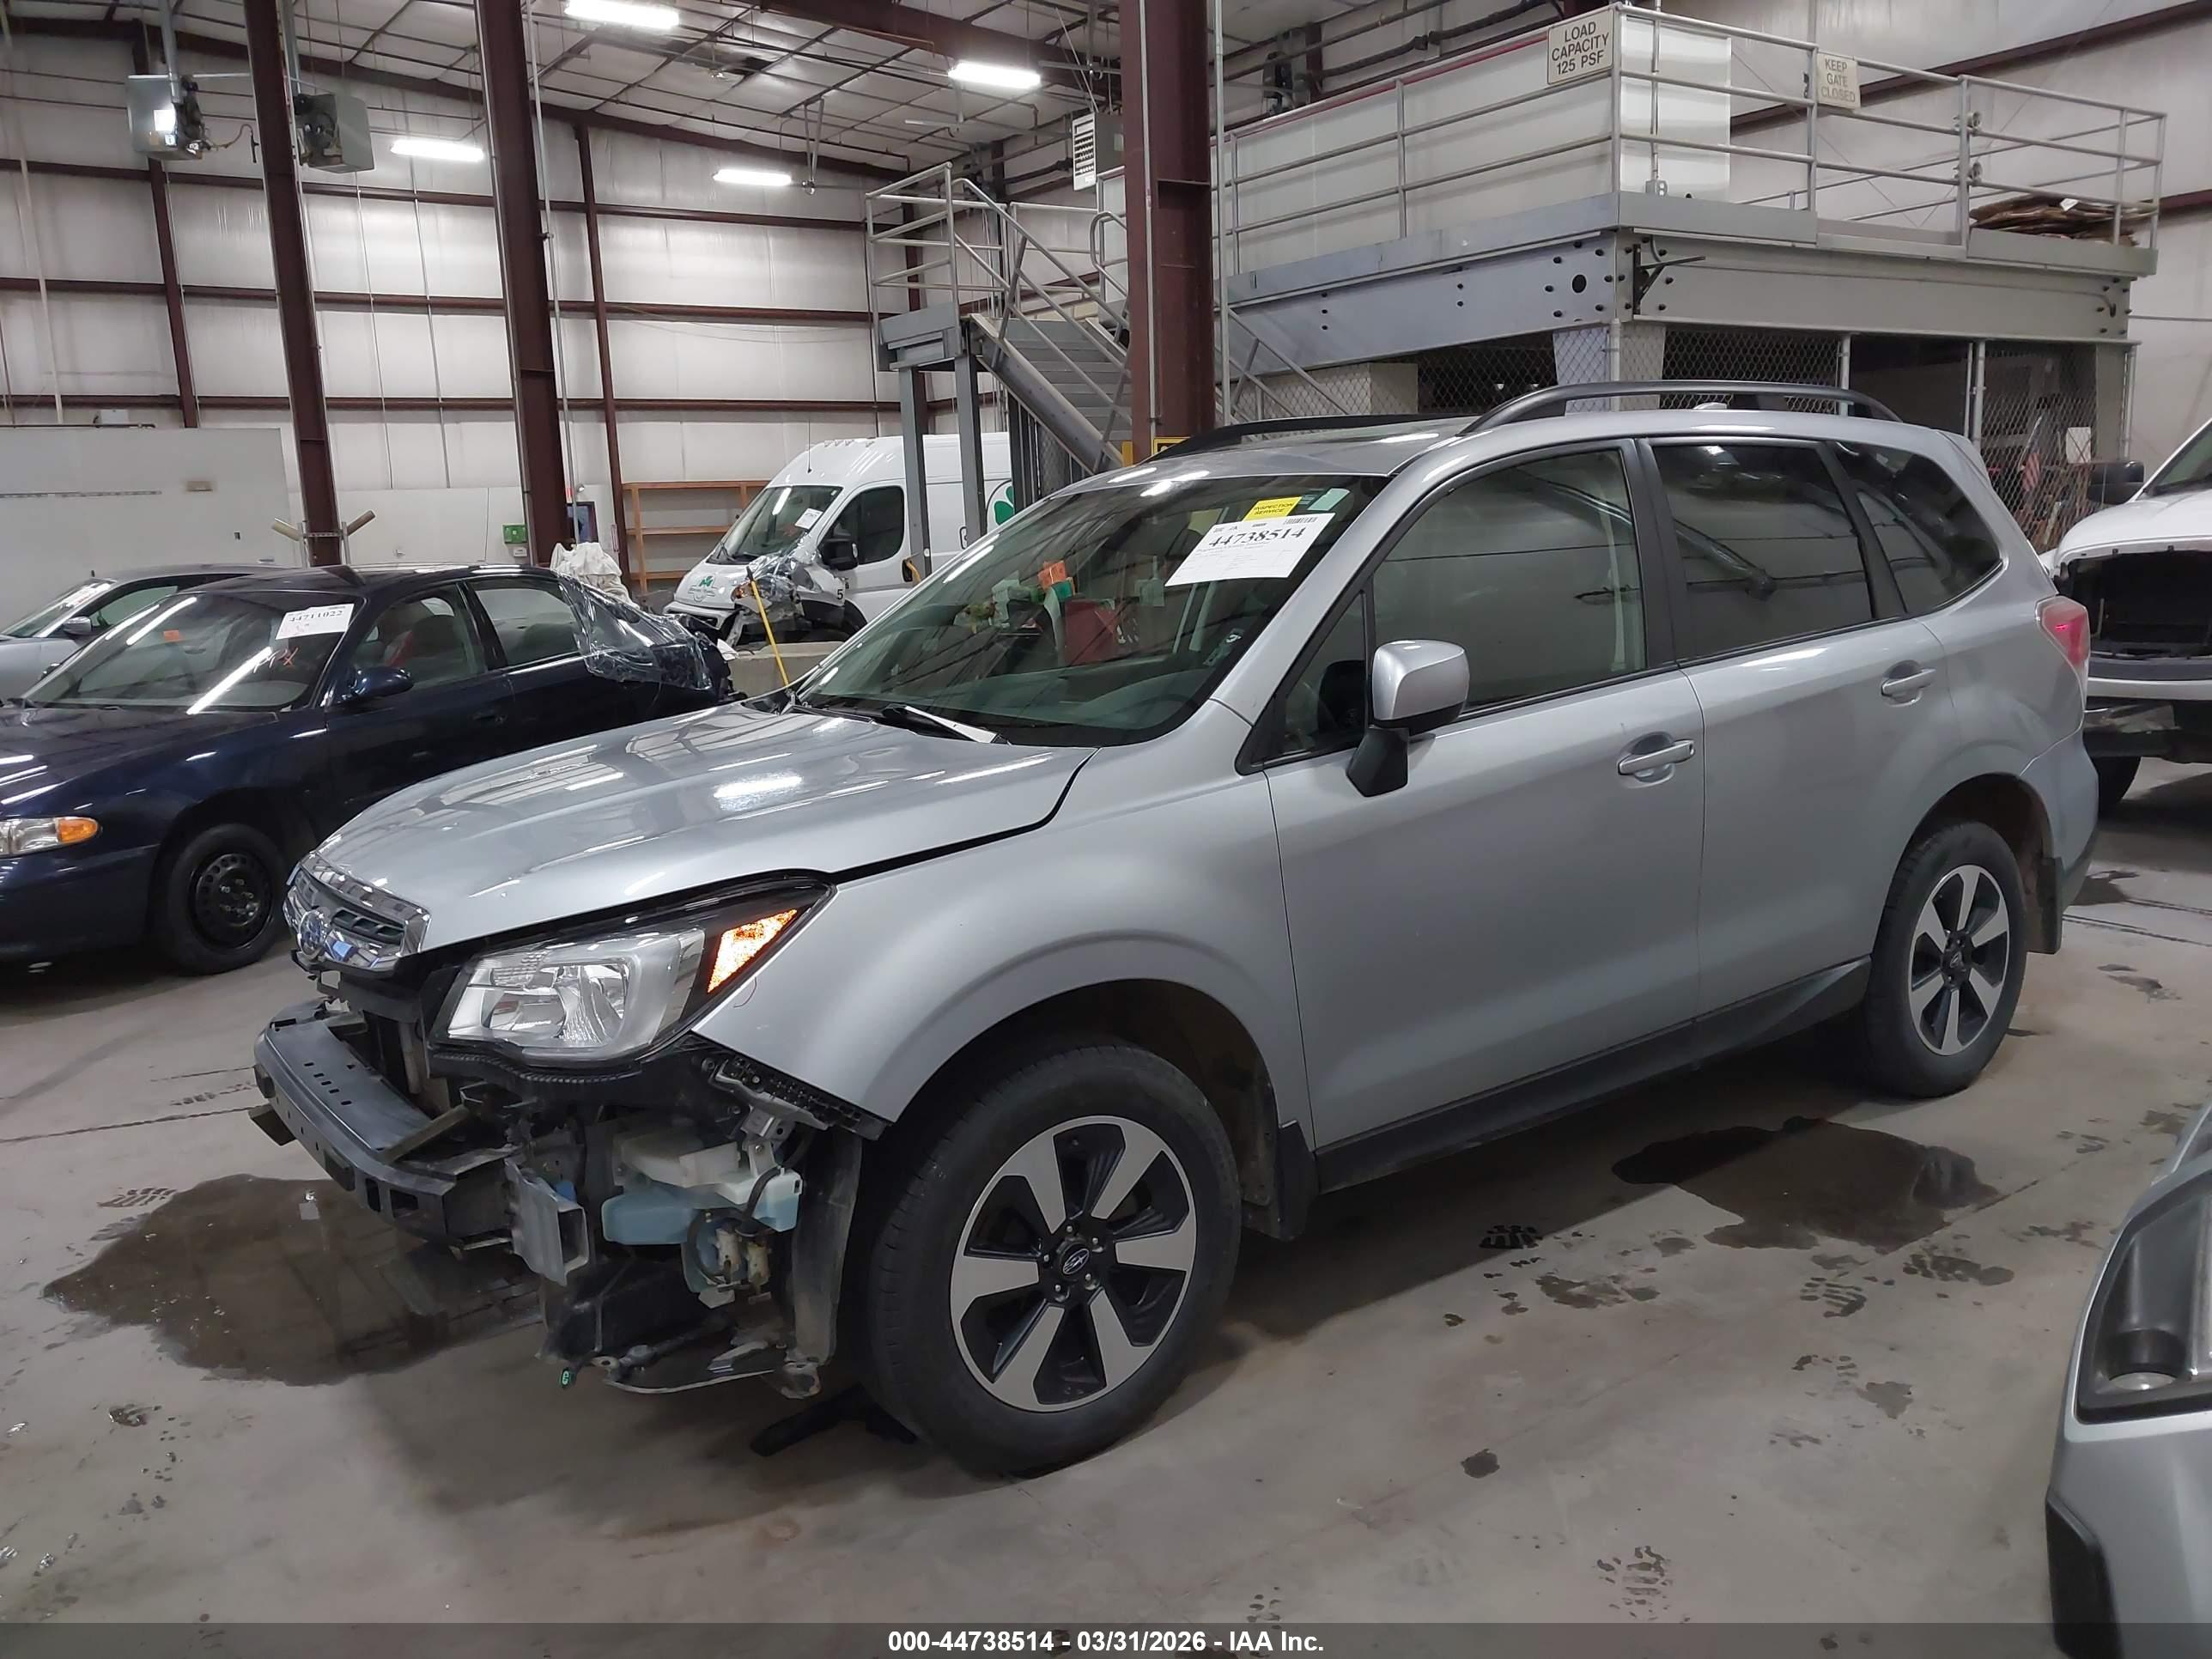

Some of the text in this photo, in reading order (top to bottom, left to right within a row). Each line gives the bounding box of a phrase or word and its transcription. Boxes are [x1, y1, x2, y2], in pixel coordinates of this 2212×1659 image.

[1565, 21, 1596, 42] LOAD
[1552, 32, 1609, 61] CAPACITY
[1557, 50, 1604, 75] 125 PSF
[1825, 58, 1847, 72] KEEP
[1827, 73, 1848, 88] GATE
[1820, 86, 1856, 102] CLOSED
[1208, 526, 1306, 547] 44738514
[837, 588, 844, 600] 5
